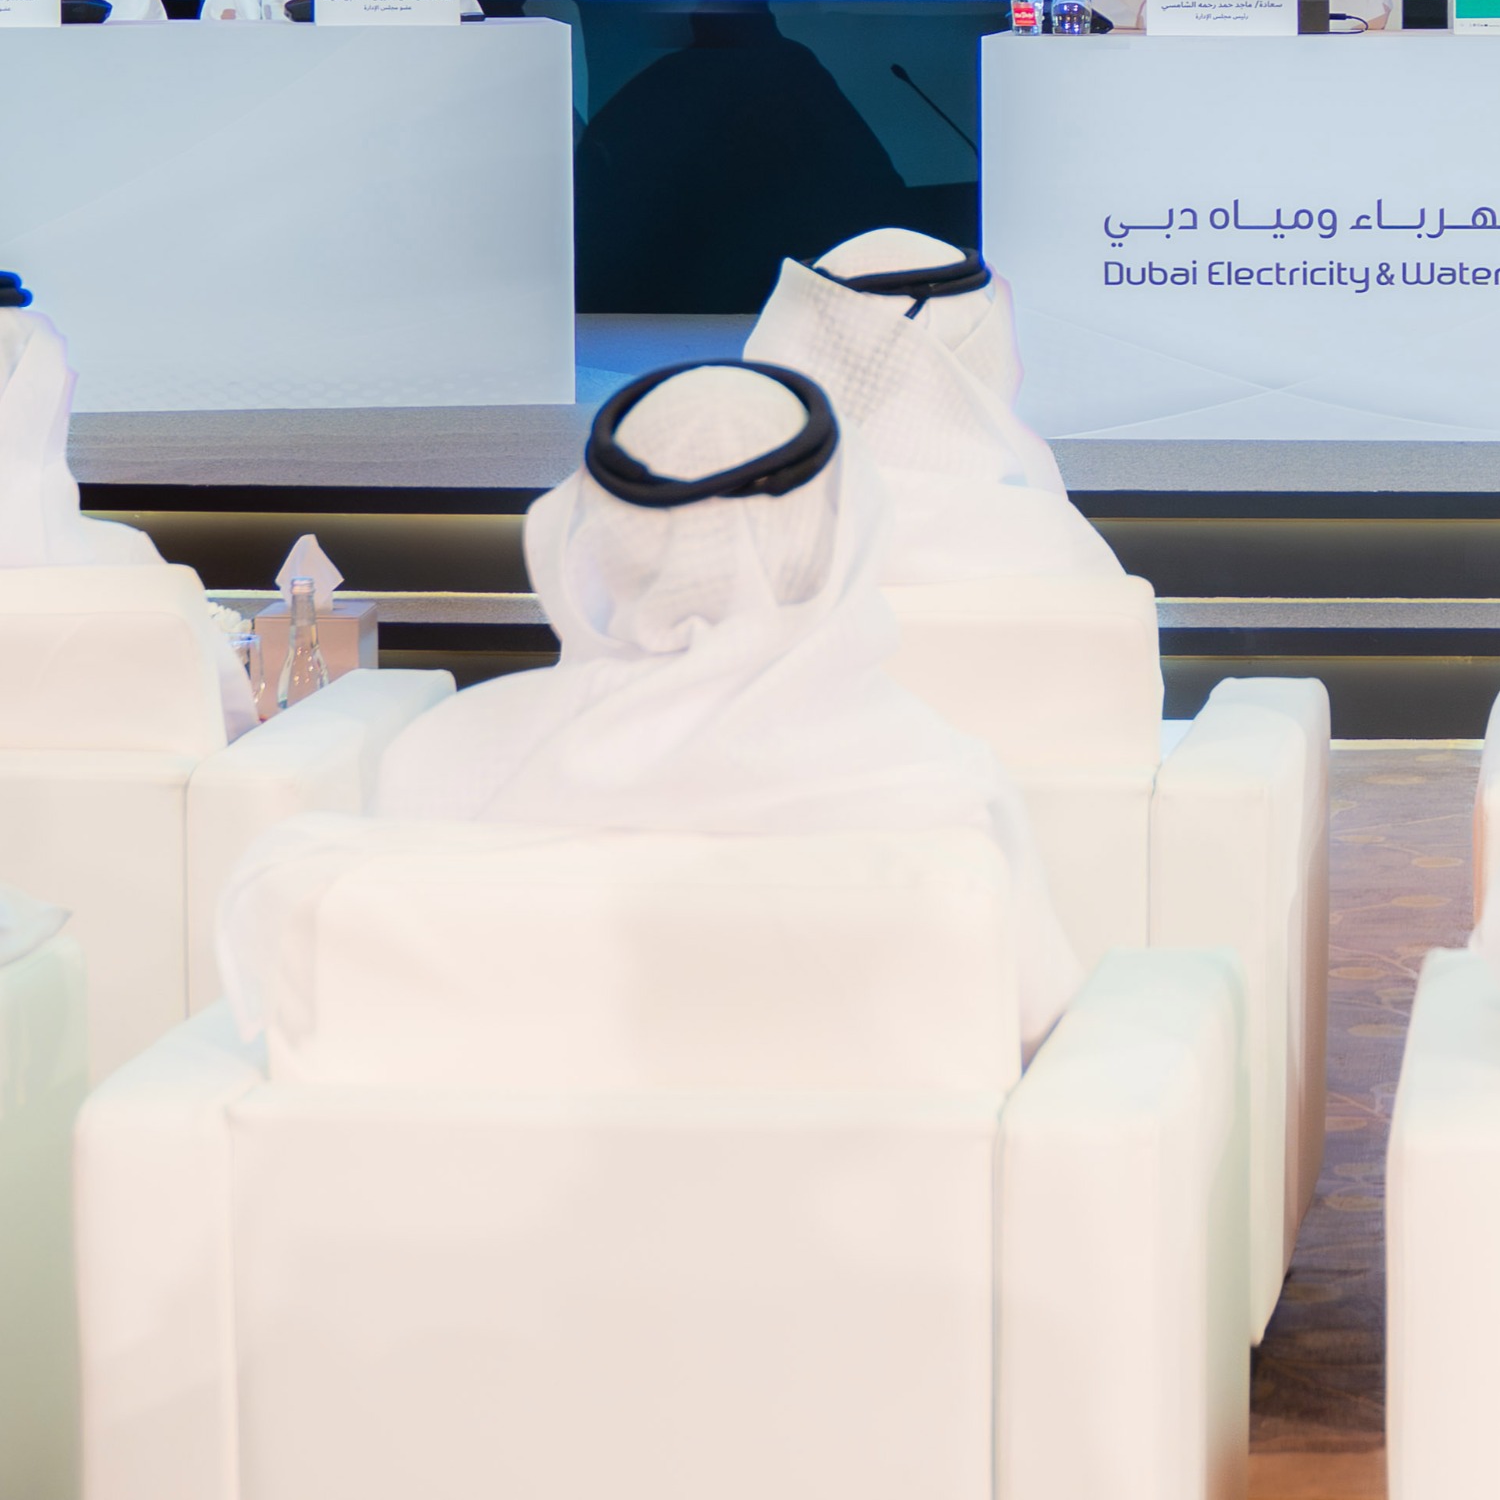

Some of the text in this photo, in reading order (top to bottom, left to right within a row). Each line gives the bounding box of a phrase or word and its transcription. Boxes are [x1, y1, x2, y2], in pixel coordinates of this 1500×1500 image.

[1161, 0, 1196, 12] الشامسي
[1235, 1, 1252, 10] ماجد
[1103, 207, 1198, 248] دبي
[1209, 198, 1338, 240] ومياه
[1104, 259, 1197, 286] Dubai
[1207, 260, 1370, 294] Electricity
[1375, 262, 1395, 286] &
